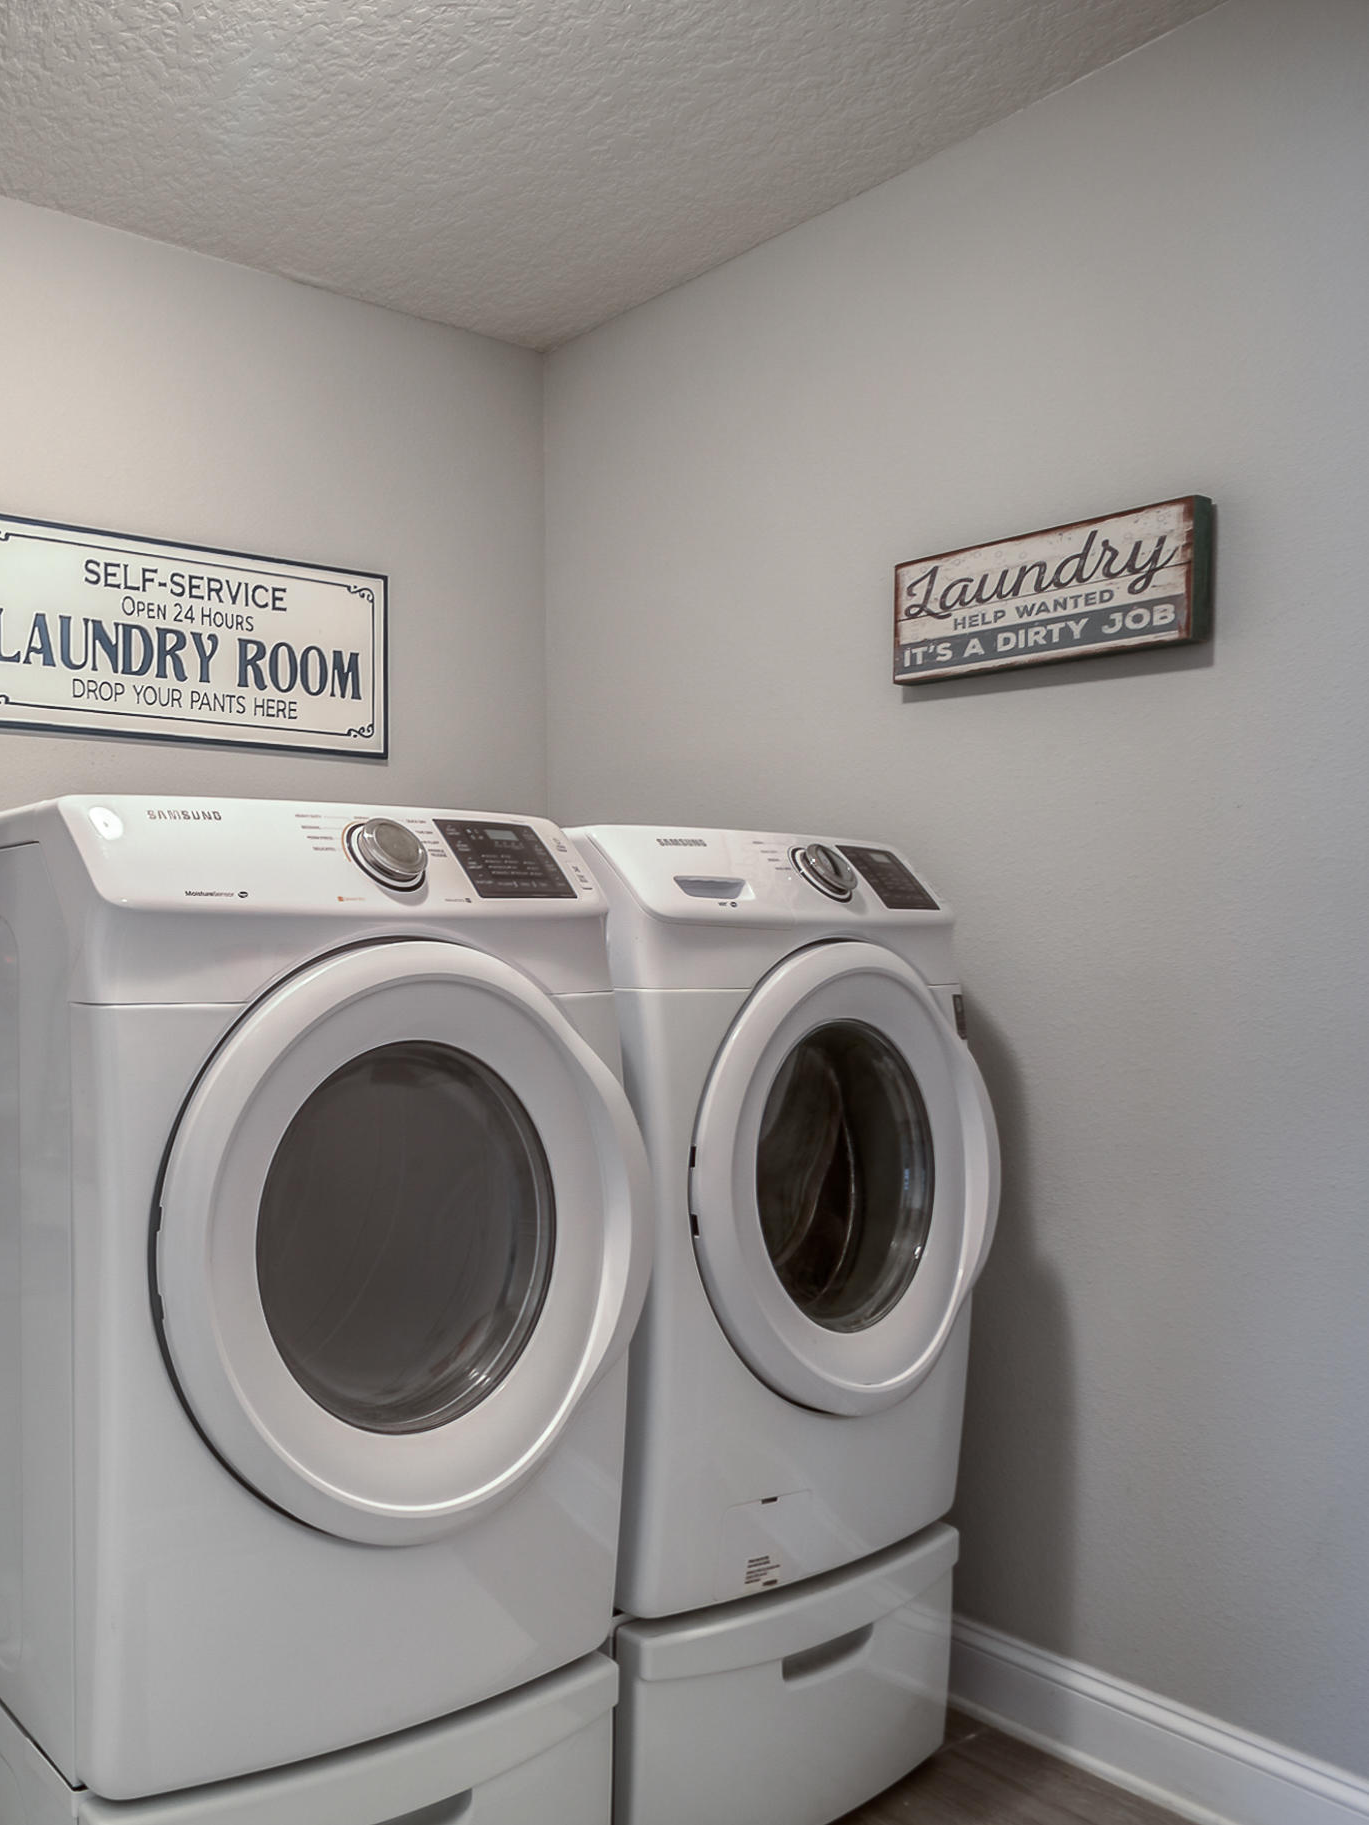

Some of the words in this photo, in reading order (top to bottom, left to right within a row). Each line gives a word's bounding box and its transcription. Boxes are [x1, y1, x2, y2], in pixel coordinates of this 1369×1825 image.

[83, 558, 287, 612] SELF-SERVICE
[904, 529, 1180, 620] Laundry
[121, 595, 167, 621] OPEN
[172, 602, 195, 624] 24
[201, 607, 254, 632] HOURS
[953, 609, 1006, 632] HELP
[1015, 589, 1115, 619] WANTED
[903, 642, 953, 668] IT'S
[962, 638, 985, 657] A
[996, 617, 1090, 652] DIRTY
[1102, 603, 1176, 635] JOB
[237, 637, 362, 700] ROOM
[72, 678, 125, 703] DROP
[133, 685, 182, 709] YOUR
[190, 690, 246, 715] PANTS
[253, 699, 298, 720] HERE
[147, 809, 222, 821] SAMSUNG
[656, 838, 707, 847] SAMSUNG
